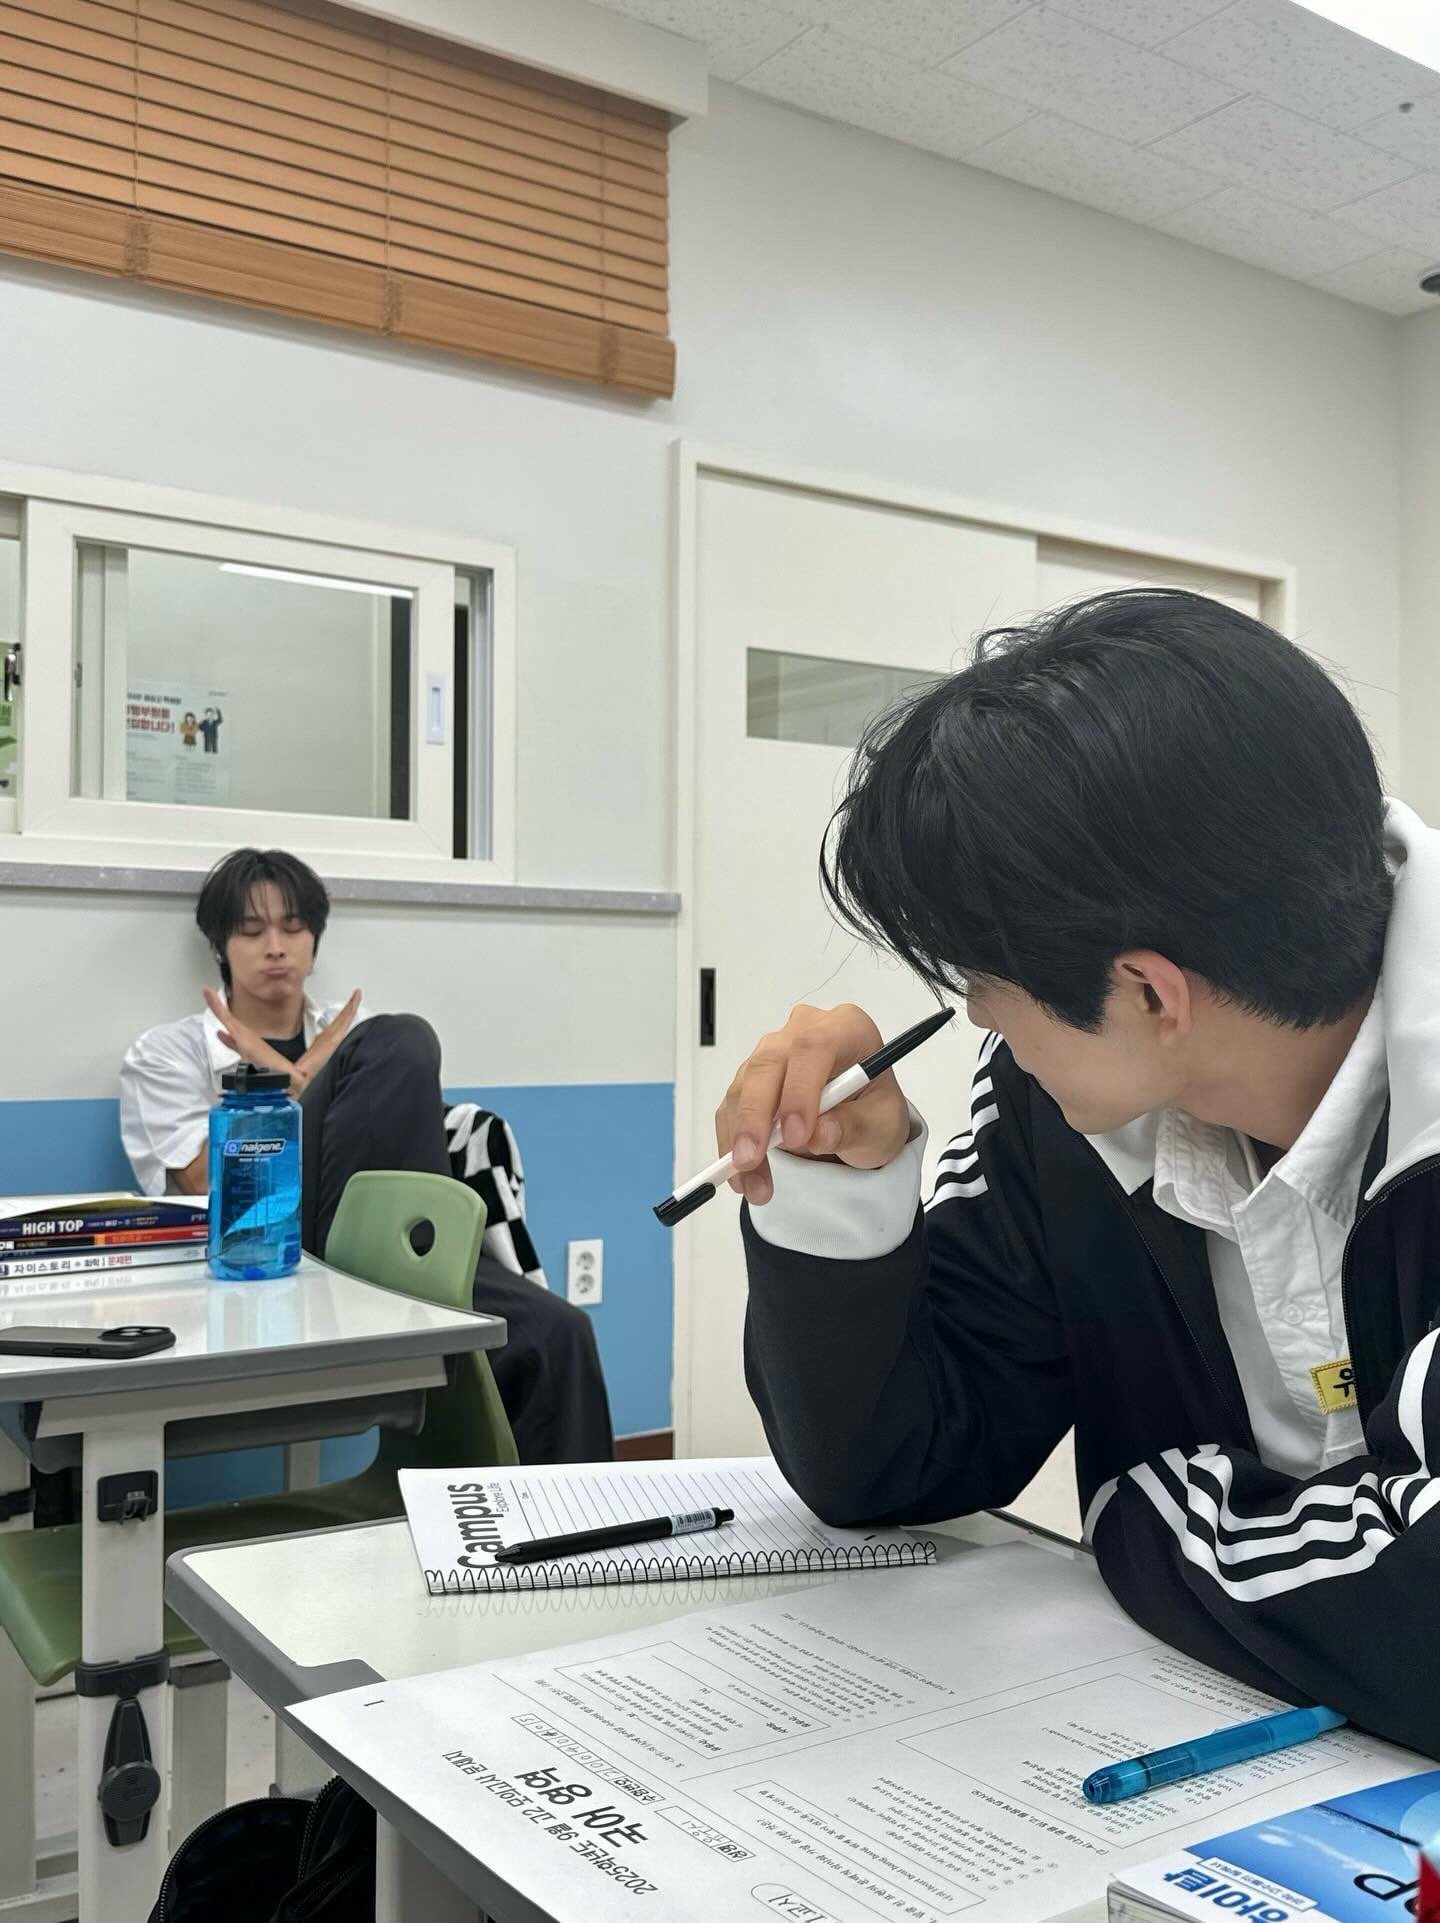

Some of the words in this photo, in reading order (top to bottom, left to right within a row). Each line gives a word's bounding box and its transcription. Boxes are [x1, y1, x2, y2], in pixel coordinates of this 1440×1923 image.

[22, 1221, 56, 1236] HIGH
[57, 1219, 84, 1232] TOP
[14, 1260, 71, 1274] 자이스토리
[446, 1483, 510, 1569] Campus
[363, 1699, 384, 1707] 1
[442, 1750, 487, 1774] 문제지
[475, 1774, 533, 1807] 모의고사
[515, 1767, 592, 1804] 영역
[613, 1777, 657, 1803] 수험번호
[521, 1806, 557, 1824] 고2
[572, 1806, 646, 1847] 국어
[544, 1823, 579, 1840] 9월
[717, 1843, 749, 1860] 성명
[570, 1840, 657, 1894] 2025학년도
[769, 1894, 824, 1923] 1교시
